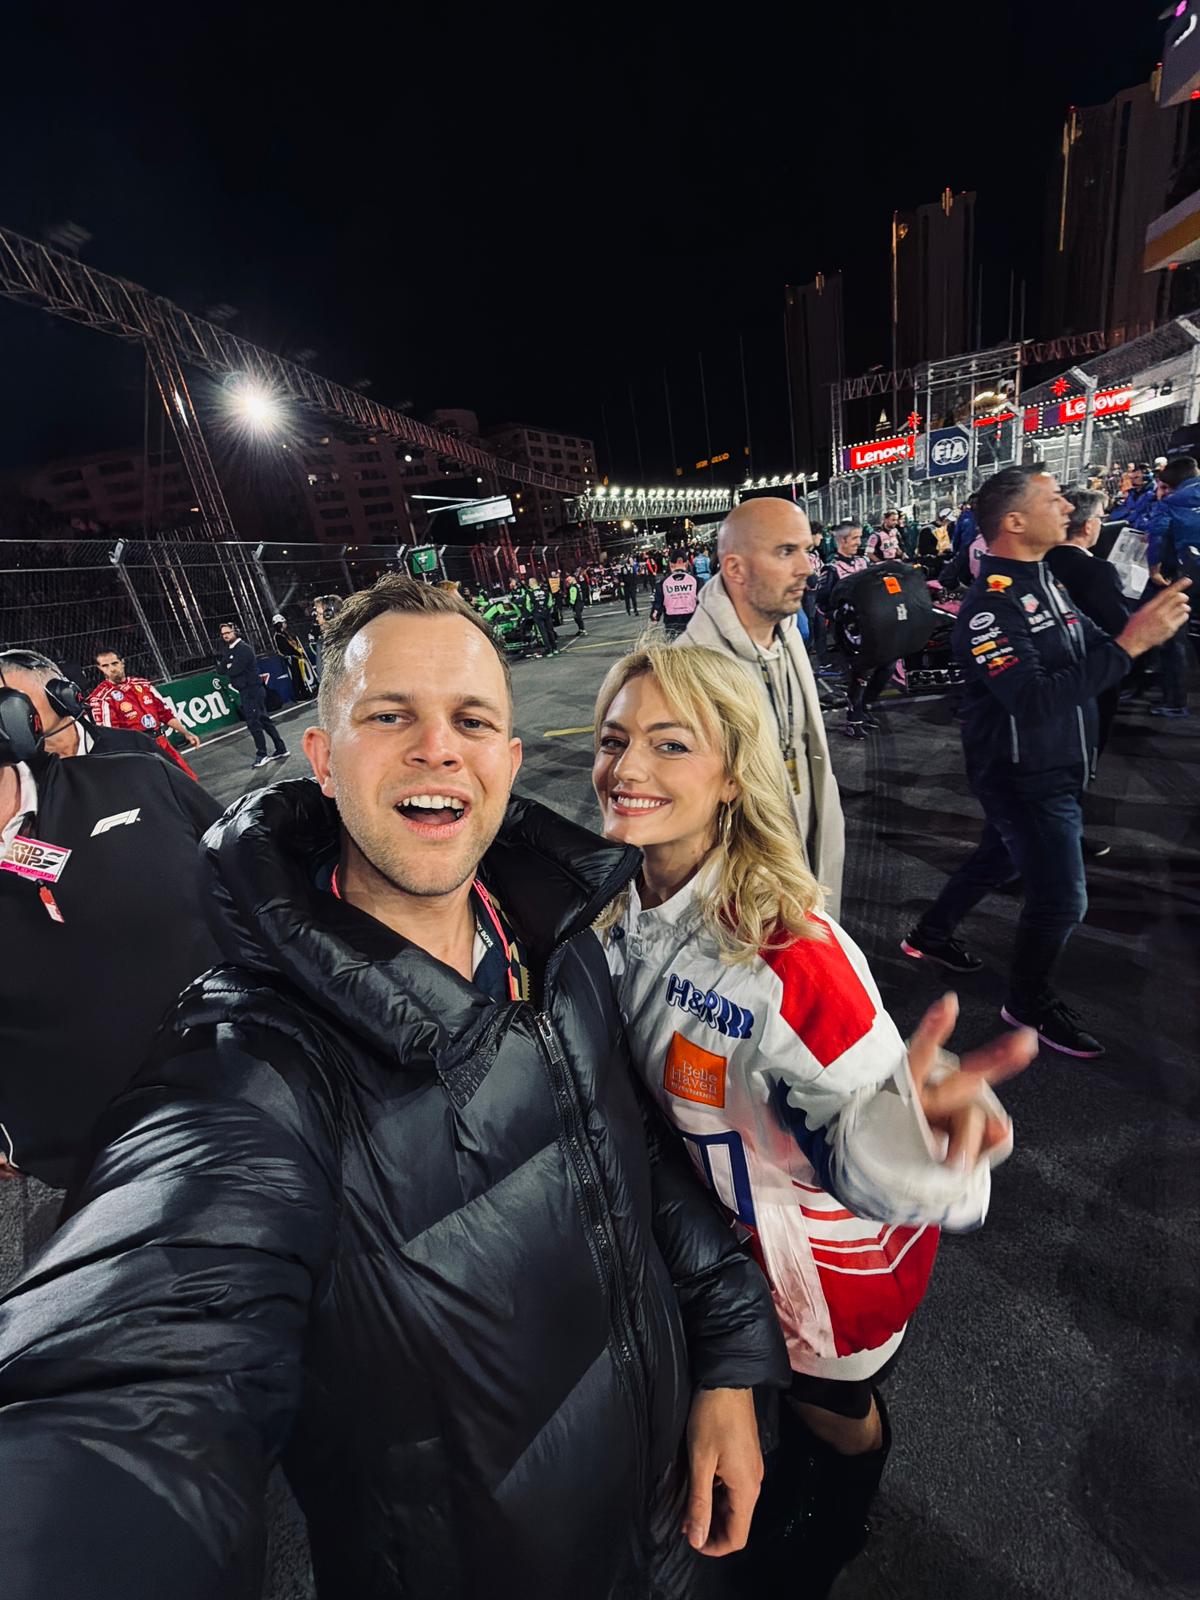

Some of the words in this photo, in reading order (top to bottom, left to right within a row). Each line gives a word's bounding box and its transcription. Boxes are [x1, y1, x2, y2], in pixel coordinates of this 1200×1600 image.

[1065, 391, 1127, 417] Leovo
[674, 584, 693, 592] BWT
[163, 691, 230, 733] ken
[672, 1066, 717, 1095] Haven
[683, 1059, 718, 1084] Belle
